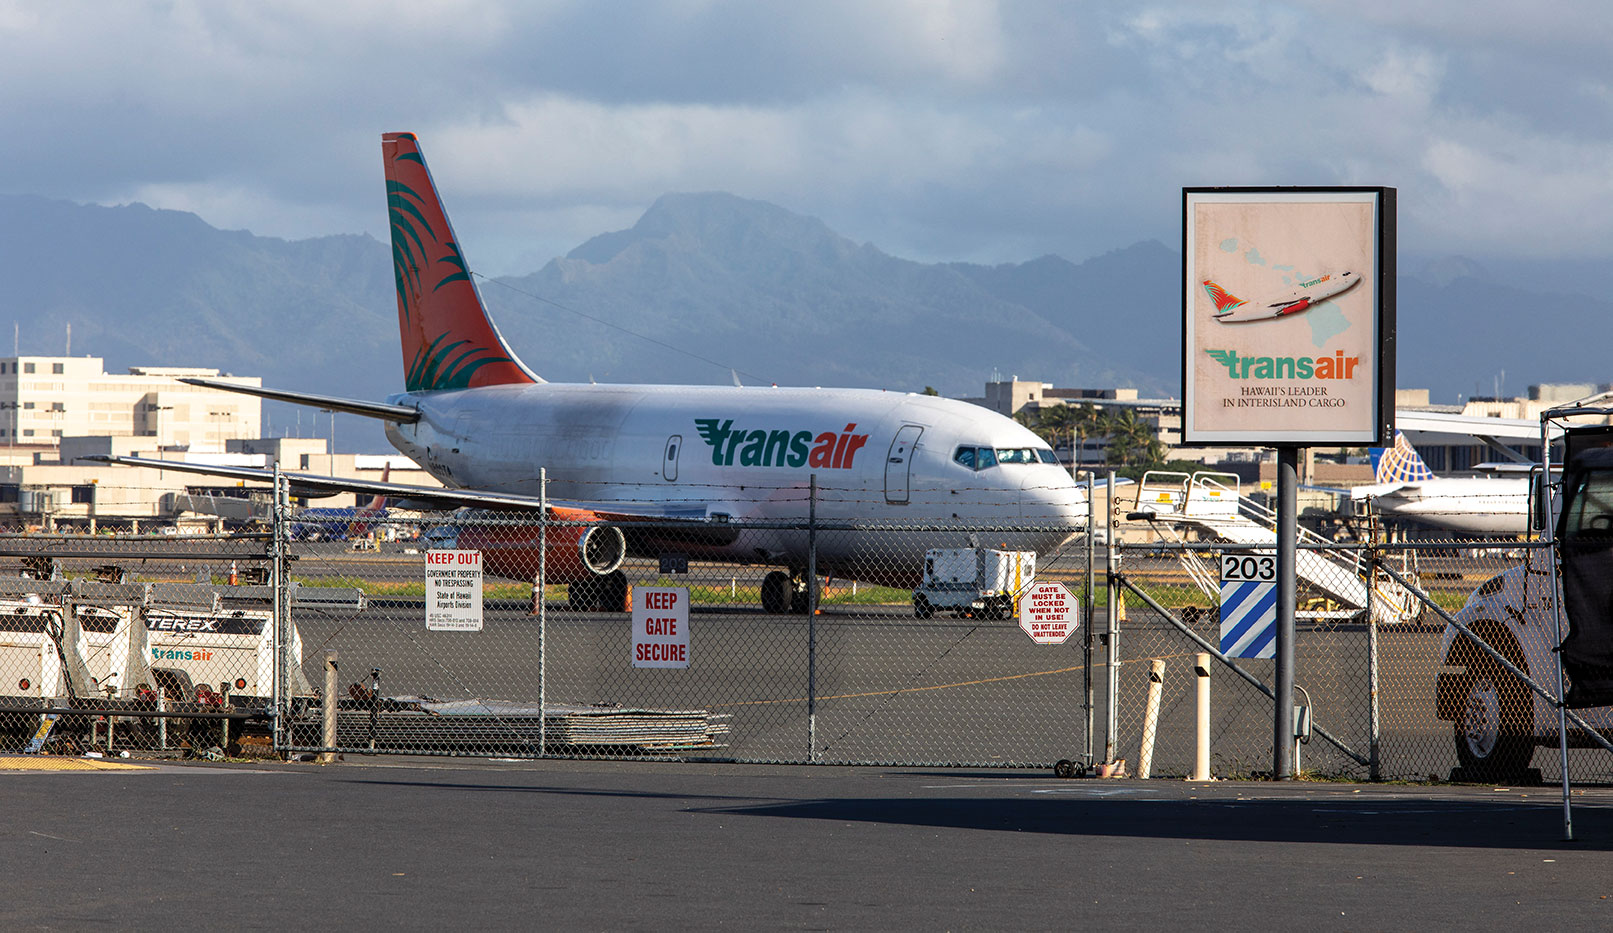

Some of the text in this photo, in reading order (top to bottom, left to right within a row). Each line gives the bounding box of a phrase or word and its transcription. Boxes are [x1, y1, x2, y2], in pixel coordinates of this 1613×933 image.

[1299, 274, 1331, 289] transair
[1205, 350, 1359, 379] transair
[1241, 386, 1328, 396] HAWAII'S LEADER
[1223, 398, 1346, 408] IN INTERISLAND CARGO
[694, 418, 870, 469] transair
[427, 553, 480, 565] KEEP OUT
[427, 569, 481, 578] GOVERNMENT PROPERTY
[1224, 556, 1275, 580] 203
[434, 579, 474, 587] NO TRESPASSING
[436, 591, 472, 599] State of Hawaii
[645, 592, 678, 610] KEEP
[436, 601, 472, 610] Airports Division
[147, 618, 217, 631] TEREX
[645, 617, 677, 636] GATE
[151, 647, 213, 661] transair
[636, 643, 686, 661] SECURE
